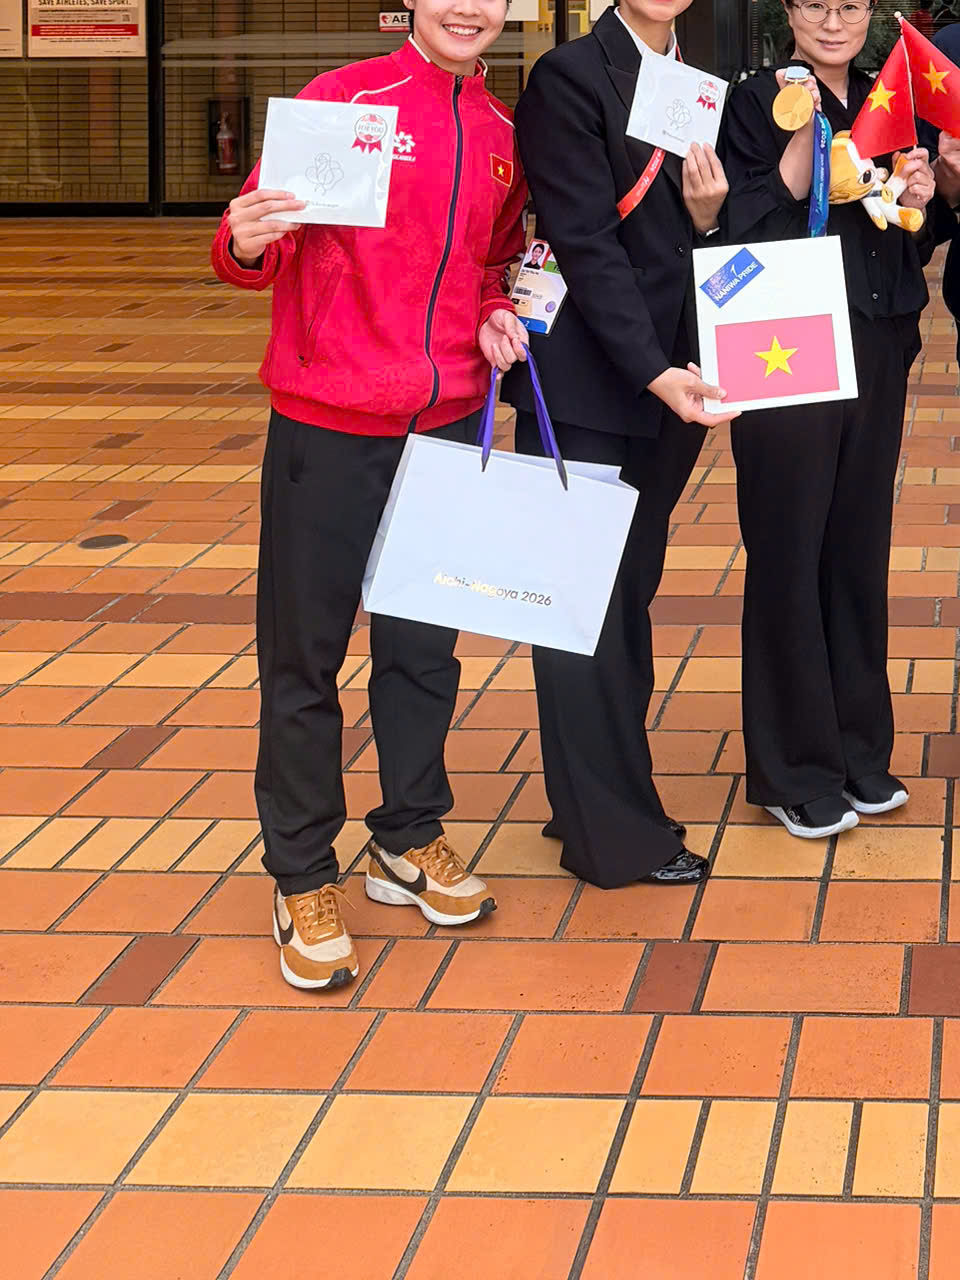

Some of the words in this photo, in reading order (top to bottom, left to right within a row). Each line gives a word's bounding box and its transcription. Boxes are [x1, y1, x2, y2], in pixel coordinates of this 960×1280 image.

[392, 15, 407, 23] AE
[738, 261, 758, 280] PRIDE
[521, 590, 552, 606] 2026
